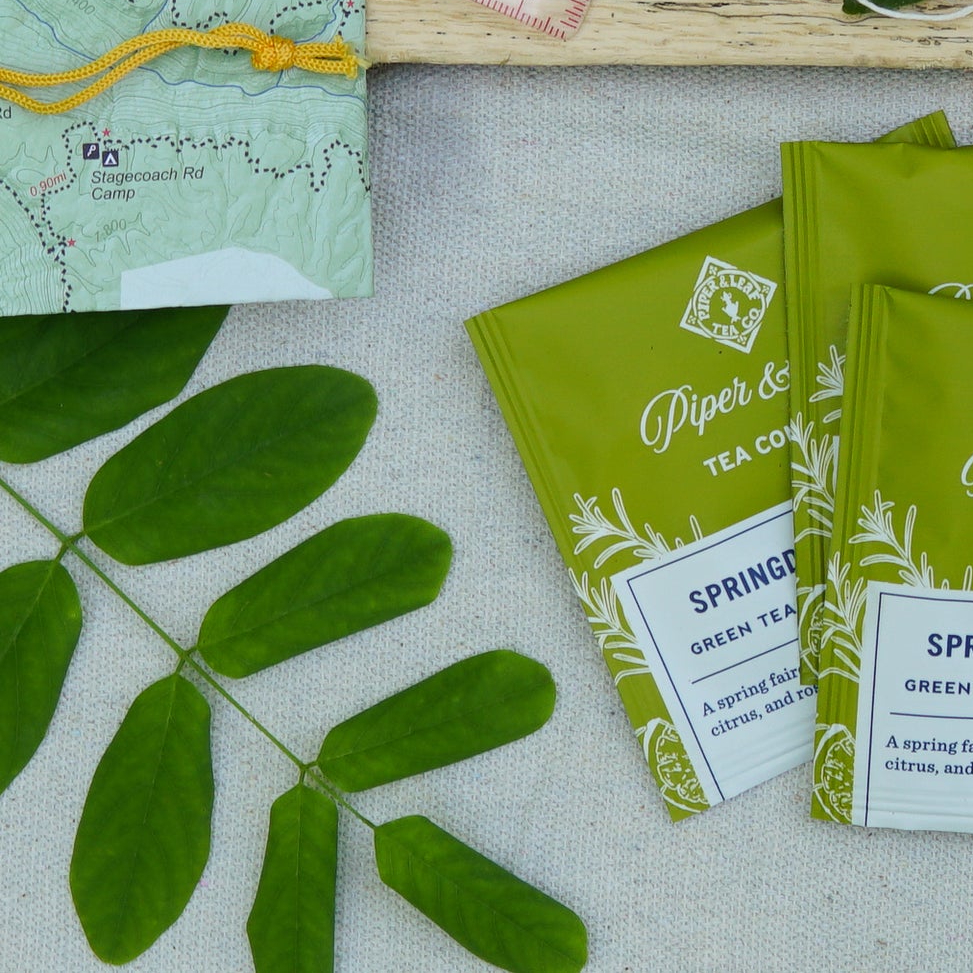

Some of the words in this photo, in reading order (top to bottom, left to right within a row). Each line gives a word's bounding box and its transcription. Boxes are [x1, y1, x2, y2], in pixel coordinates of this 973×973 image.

[30, 170, 67, 196] 0.90mi
[91, 168, 178, 186] Stagecoach
[183, 167, 205, 179] Rd
[91, 188, 136, 202] Camp
[698, 279, 719, 321] PIPER
[712, 322, 740, 336] TEA
[640, 376, 753, 455] Piper
[758, 359, 790, 400] &
[703, 445, 752, 477] TEA
[690, 621, 752, 655] GREEN
[757, 603, 797, 627] TEA
[702, 701, 716, 717] A
[717, 682, 769, 710] spring
[905, 679, 971, 695] GREEN
[711, 708, 763, 737] citrus,
[764, 691, 795, 713] and
[885, 735, 899, 749] A
[903, 738, 958, 755] spring
[885, 759, 939, 775] citrus,
